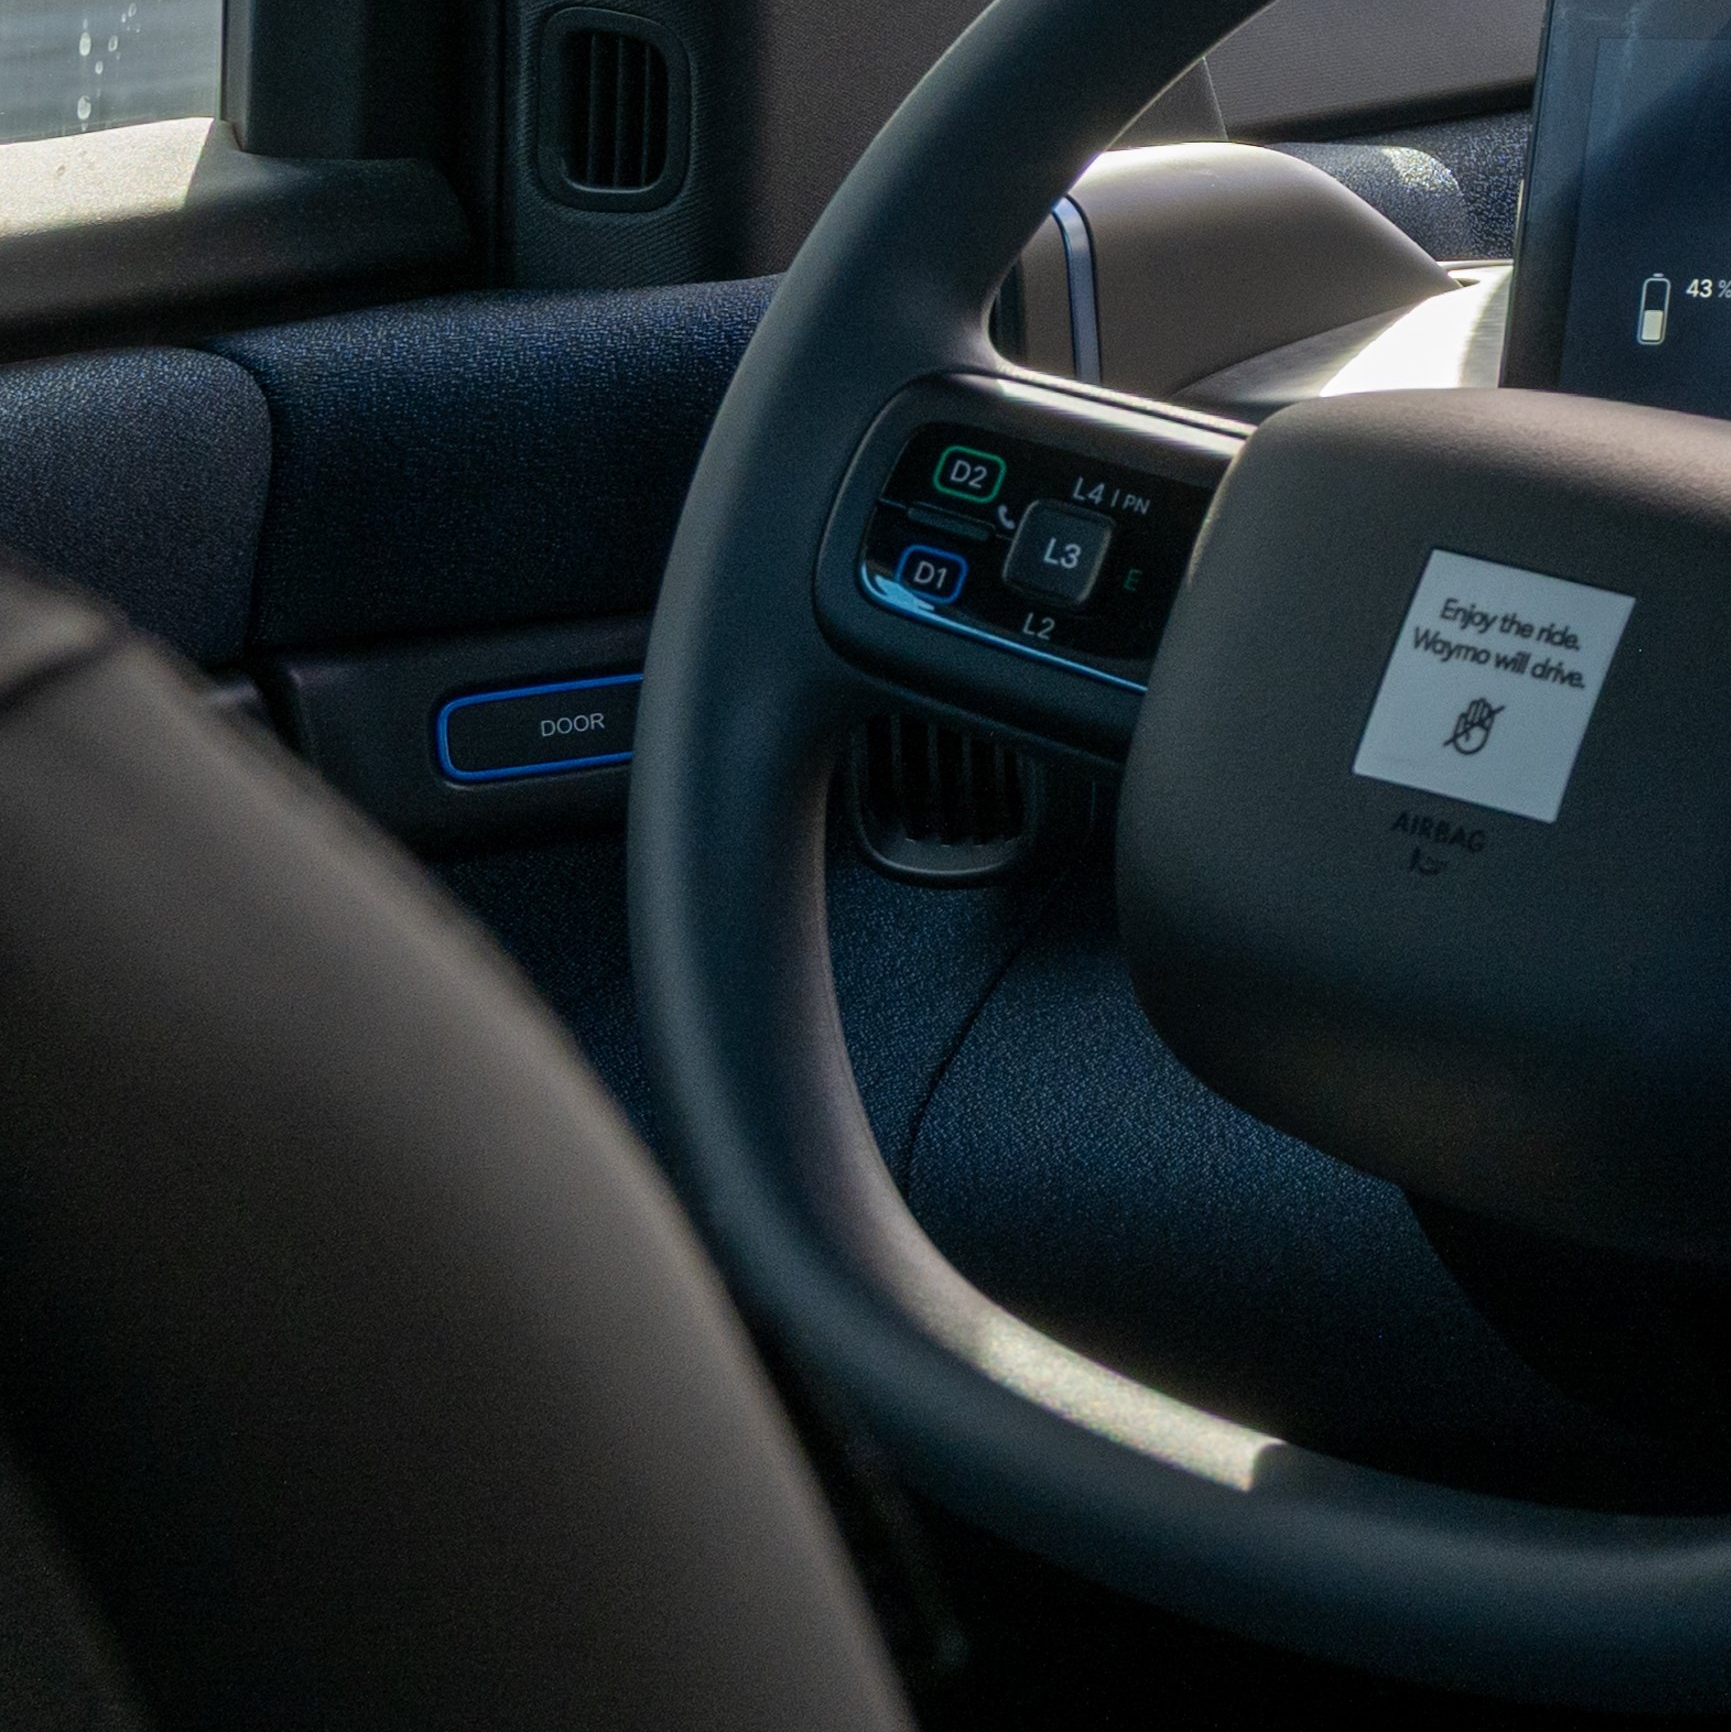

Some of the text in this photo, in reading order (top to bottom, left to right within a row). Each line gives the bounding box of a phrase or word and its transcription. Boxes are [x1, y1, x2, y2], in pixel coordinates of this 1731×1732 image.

[1685, 279, 1713, 298] 43
[949, 459, 988, 489] D2
[1072, 476, 1105, 505] L4
[1122, 494, 1150, 515] PN
[1043, 537, 1082, 569] L3
[913, 560, 948, 589] D1
[1123, 569, 1143, 592] E
[1022, 612, 1056, 641] L2
[1440, 598, 1581, 652] Enjoy the ride.
[1412, 626, 1587, 690] Waymo will drive.
[540, 712, 606, 738] DOOR
[1390, 812, 1486, 854] AIRBAG
